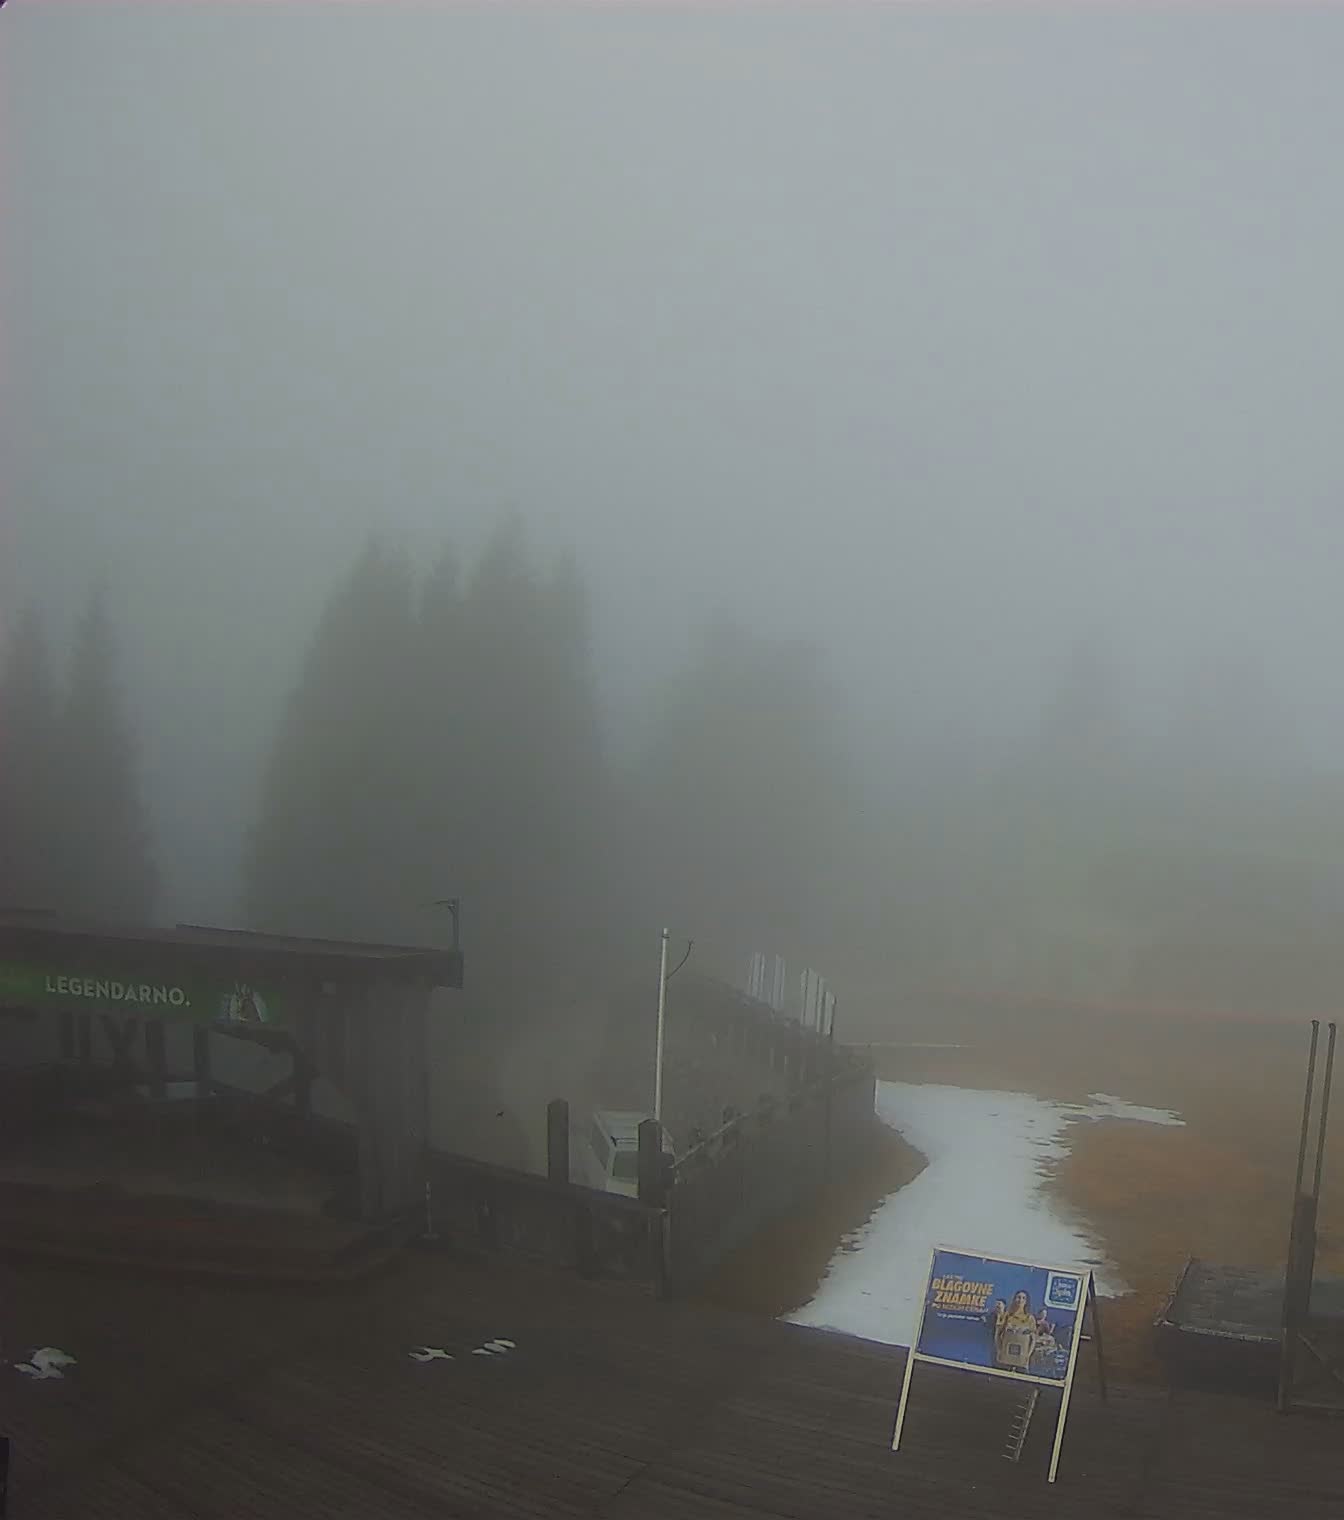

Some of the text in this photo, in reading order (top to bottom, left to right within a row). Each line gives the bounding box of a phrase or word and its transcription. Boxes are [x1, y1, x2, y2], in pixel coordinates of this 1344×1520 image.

[45, 975, 191, 1007] LEGENDARNO.
[932, 1278, 994, 1296] BLAGOVNE
[935, 1290, 988, 1307] ZNAMKE
